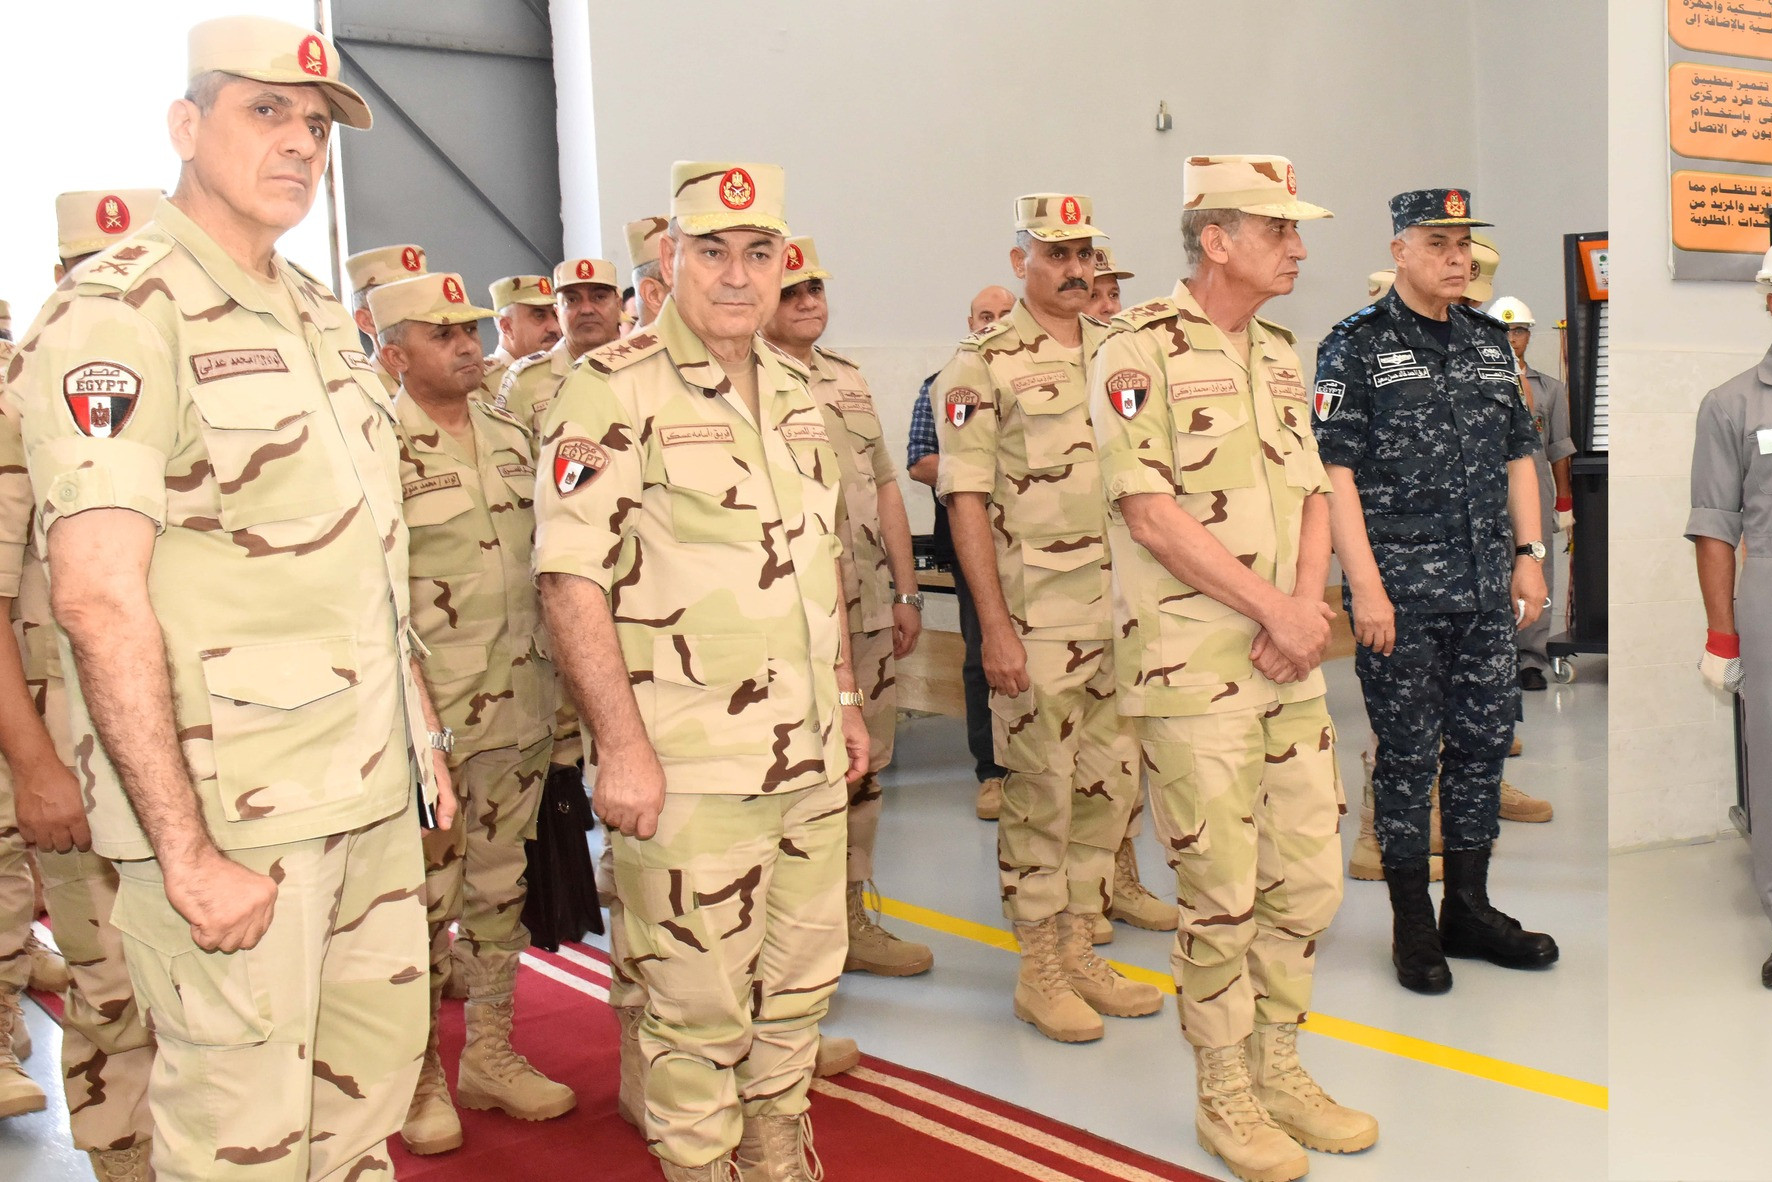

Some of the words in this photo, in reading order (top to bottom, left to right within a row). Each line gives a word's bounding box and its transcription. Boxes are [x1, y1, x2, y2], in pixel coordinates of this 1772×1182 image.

[1685, 13, 1700, 27] إلى
[1704, 14, 1745, 32] بالإضافة
[1691, 73, 1733, 89] بتطبيق
[1737, 80, 1769, 91] تتميز
[1732, 95, 1753, 106] طرد
[1691, 106, 1751, 123] بإستخدام
[1689, 121, 1727, 134] الاتصال
[1731, 127, 1747, 137] من
[1688, 180, 1706, 192] مما
[1711, 183, 1757, 195] للنظام
[1689, 199, 1706, 209] من
[1711, 199, 1744, 213] والمزيد
[81, 366, 120, 381] مصر
[76, 380, 128, 392] EGYPT
[1110, 378, 1145, 391] EGYPT
[1317, 386, 1343, 395] EGYPT
[949, 394, 975, 403] EGYPT
[666, 431, 690, 442] عسكر
[561, 445, 602, 467] EGYPT
